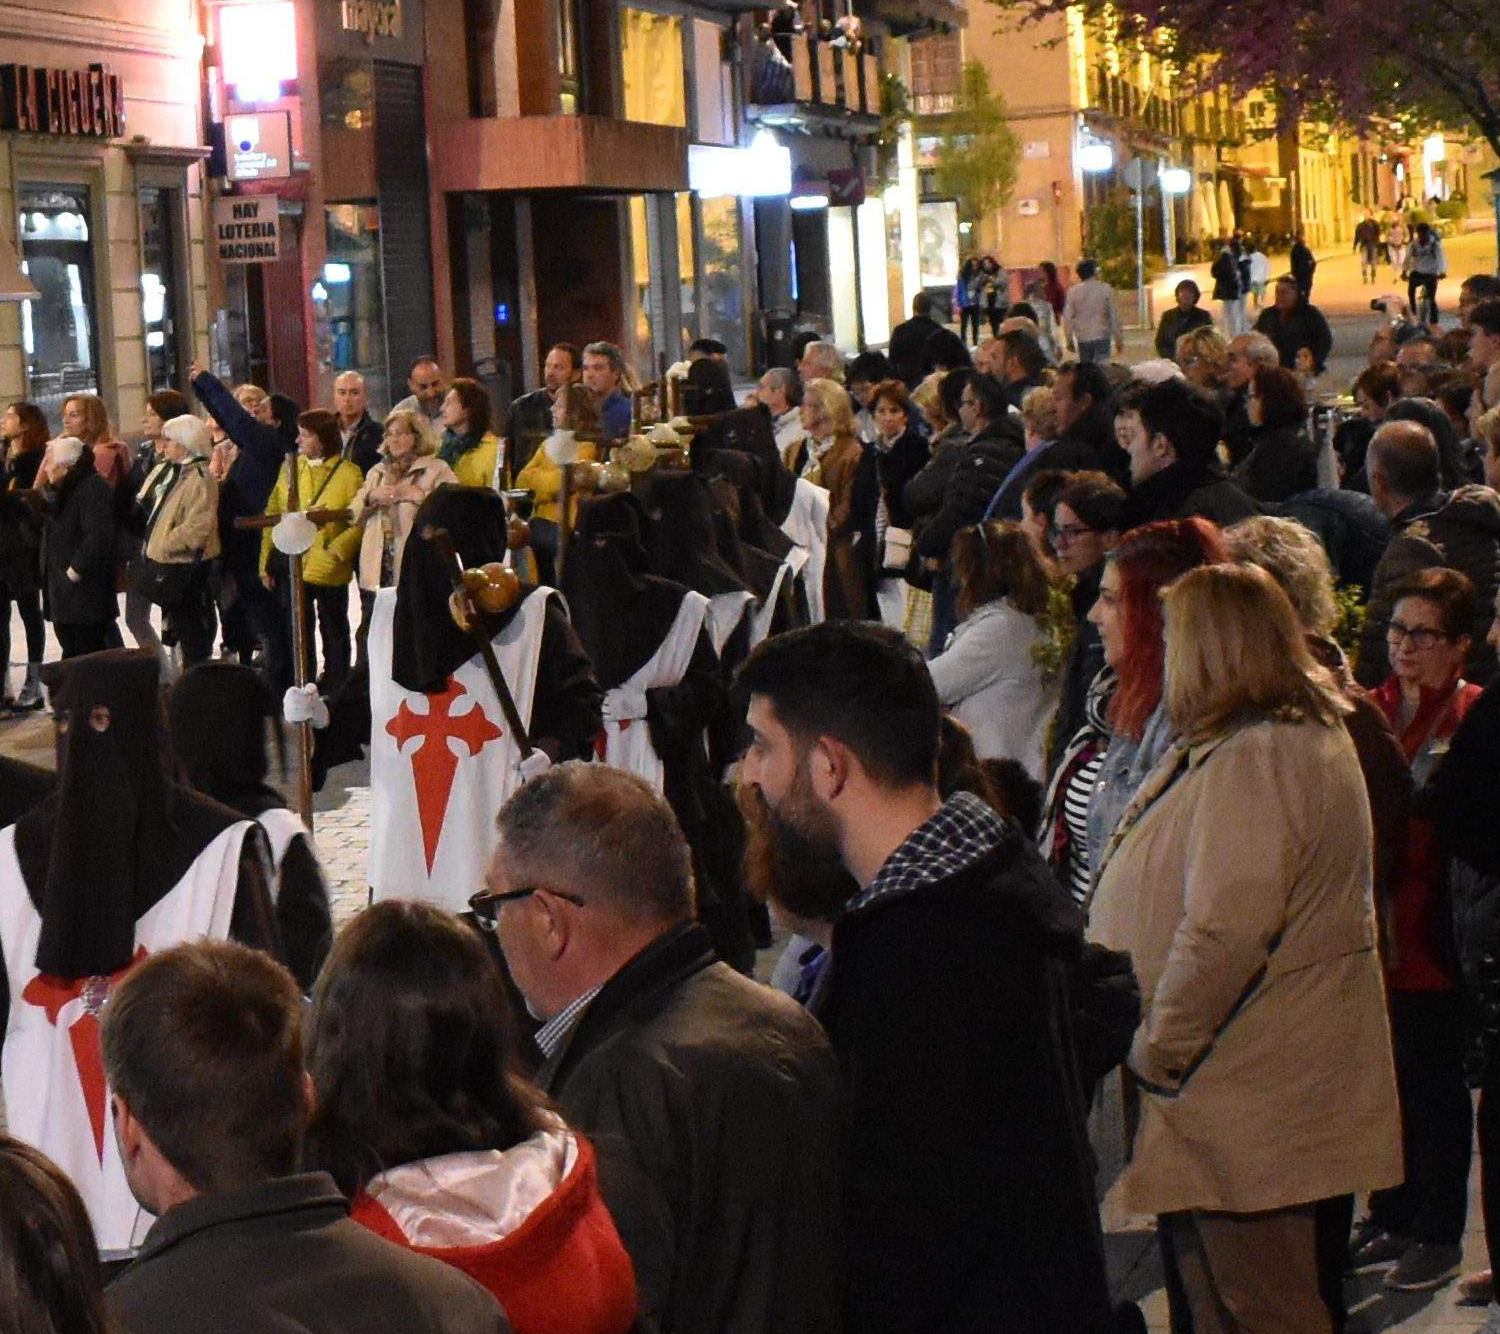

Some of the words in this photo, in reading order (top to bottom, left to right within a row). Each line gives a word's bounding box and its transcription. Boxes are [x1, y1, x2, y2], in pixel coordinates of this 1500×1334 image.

[232, 203, 259, 220] HAY
[218, 221, 276, 240] LOTERIA
[219, 241, 276, 259] NACIONAL
